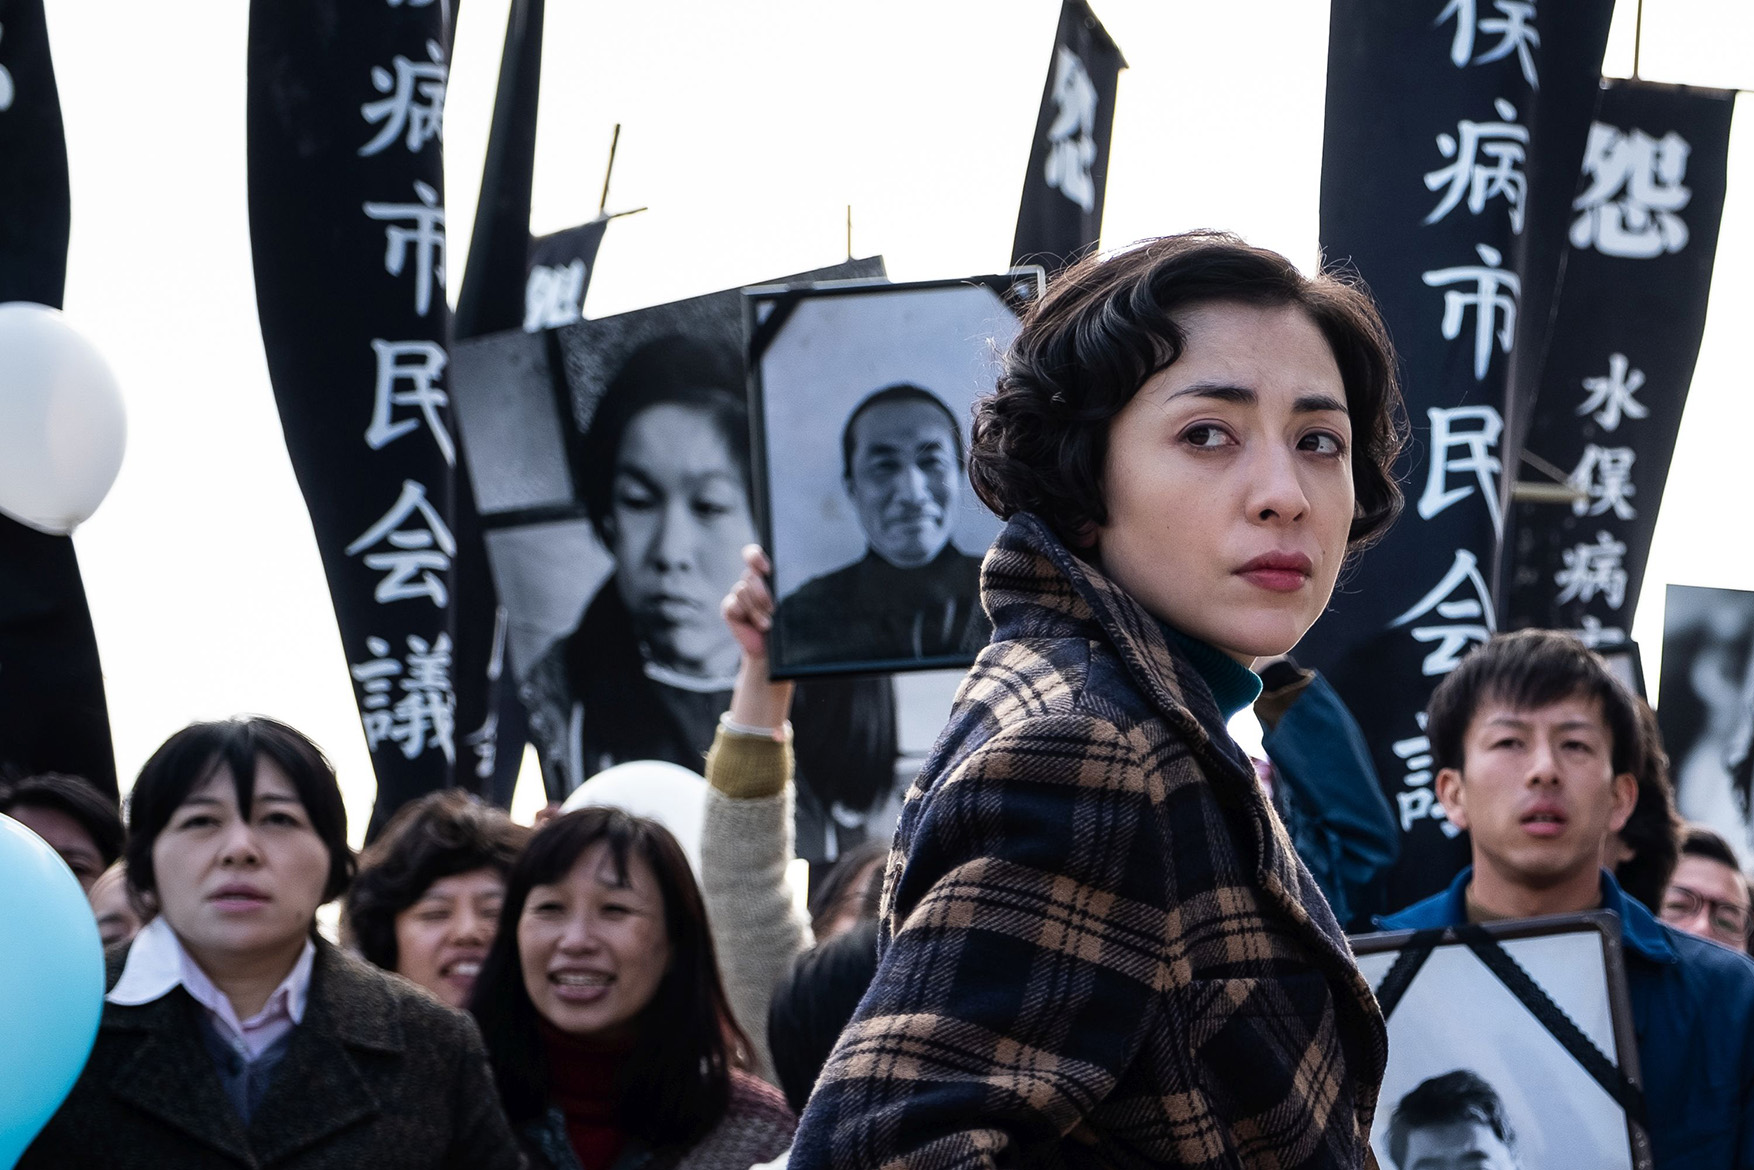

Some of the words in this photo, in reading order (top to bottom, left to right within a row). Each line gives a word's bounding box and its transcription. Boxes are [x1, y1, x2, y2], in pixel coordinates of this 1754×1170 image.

[1568, 121, 1692, 260] 怨
[346, 0, 459, 763] 病市民会議
[1554, 352, 1649, 648] 水俣病
